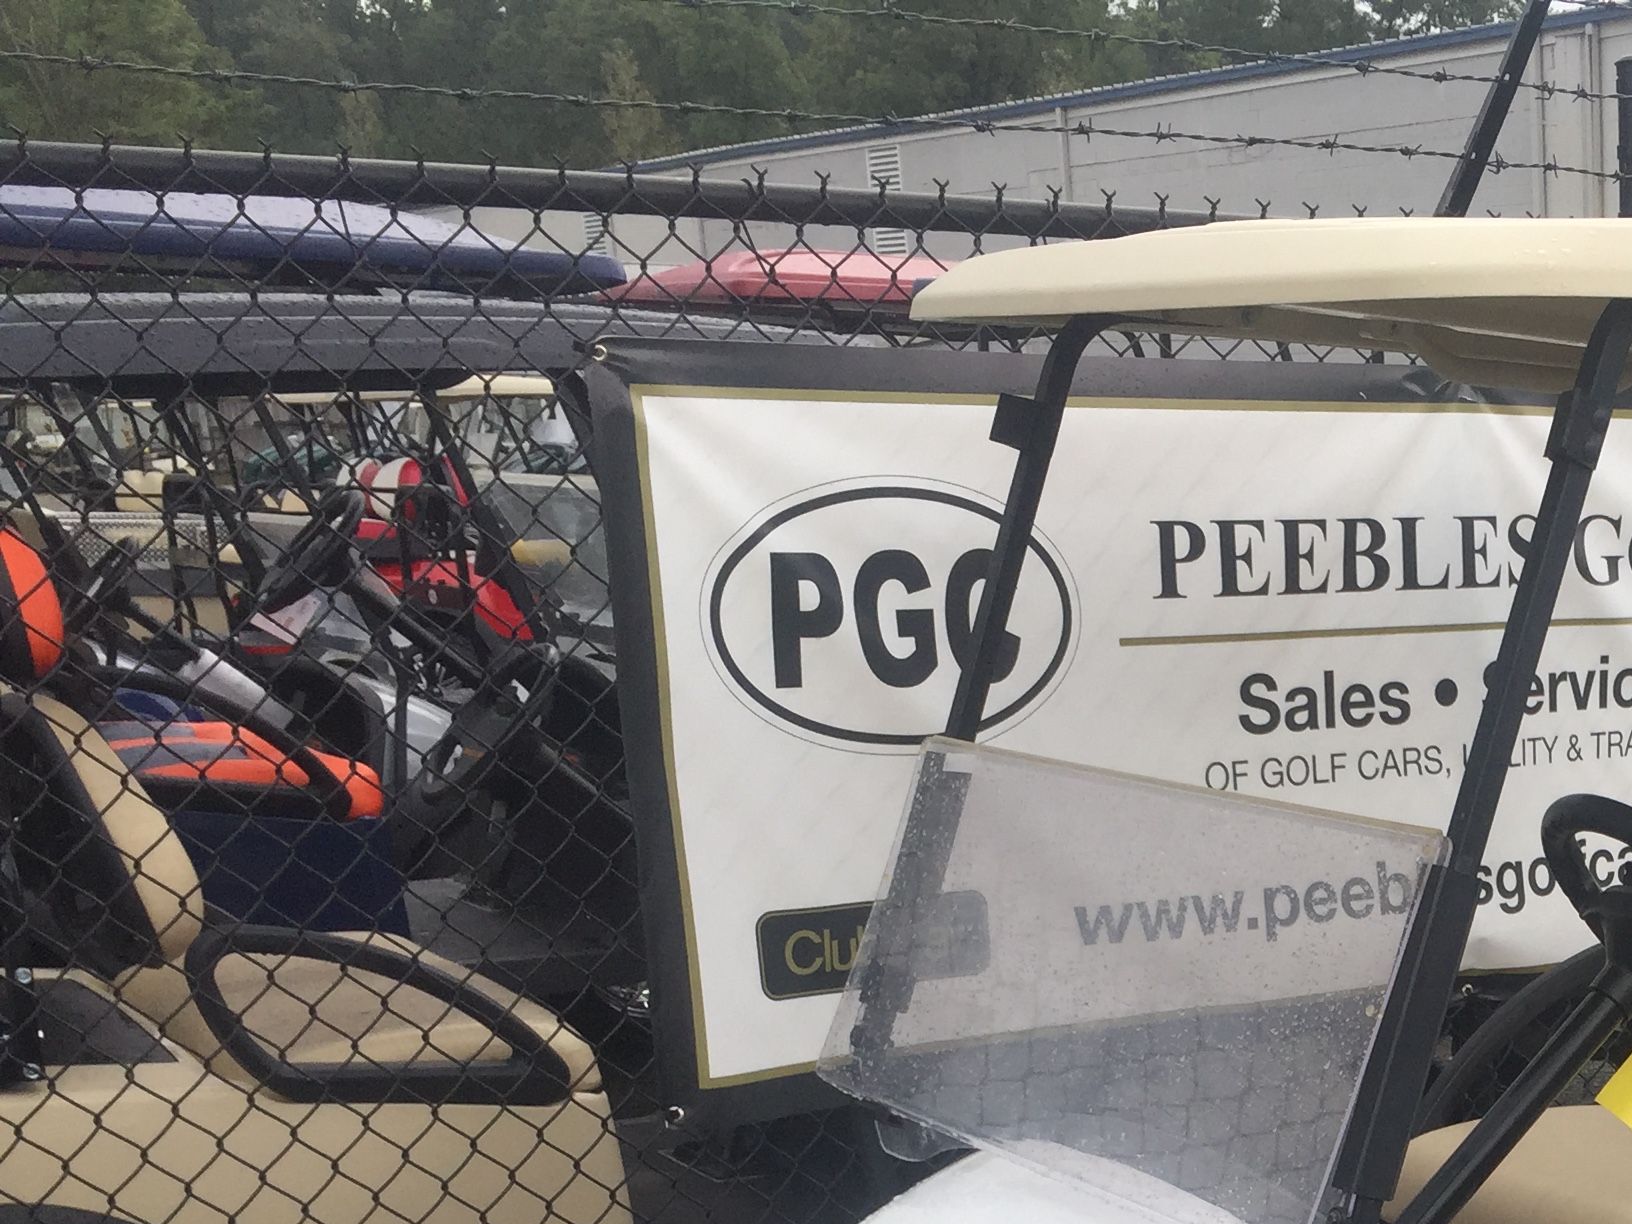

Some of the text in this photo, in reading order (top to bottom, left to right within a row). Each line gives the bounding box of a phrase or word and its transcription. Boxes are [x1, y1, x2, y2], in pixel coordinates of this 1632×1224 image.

[1238, 670, 1412, 735] Sales
[1204, 760, 1250, 791] OF
[1260, 752, 1348, 789] GOLF
[1357, 745, 1452, 783] CARS,
[1566, 734, 1584, 762] &
